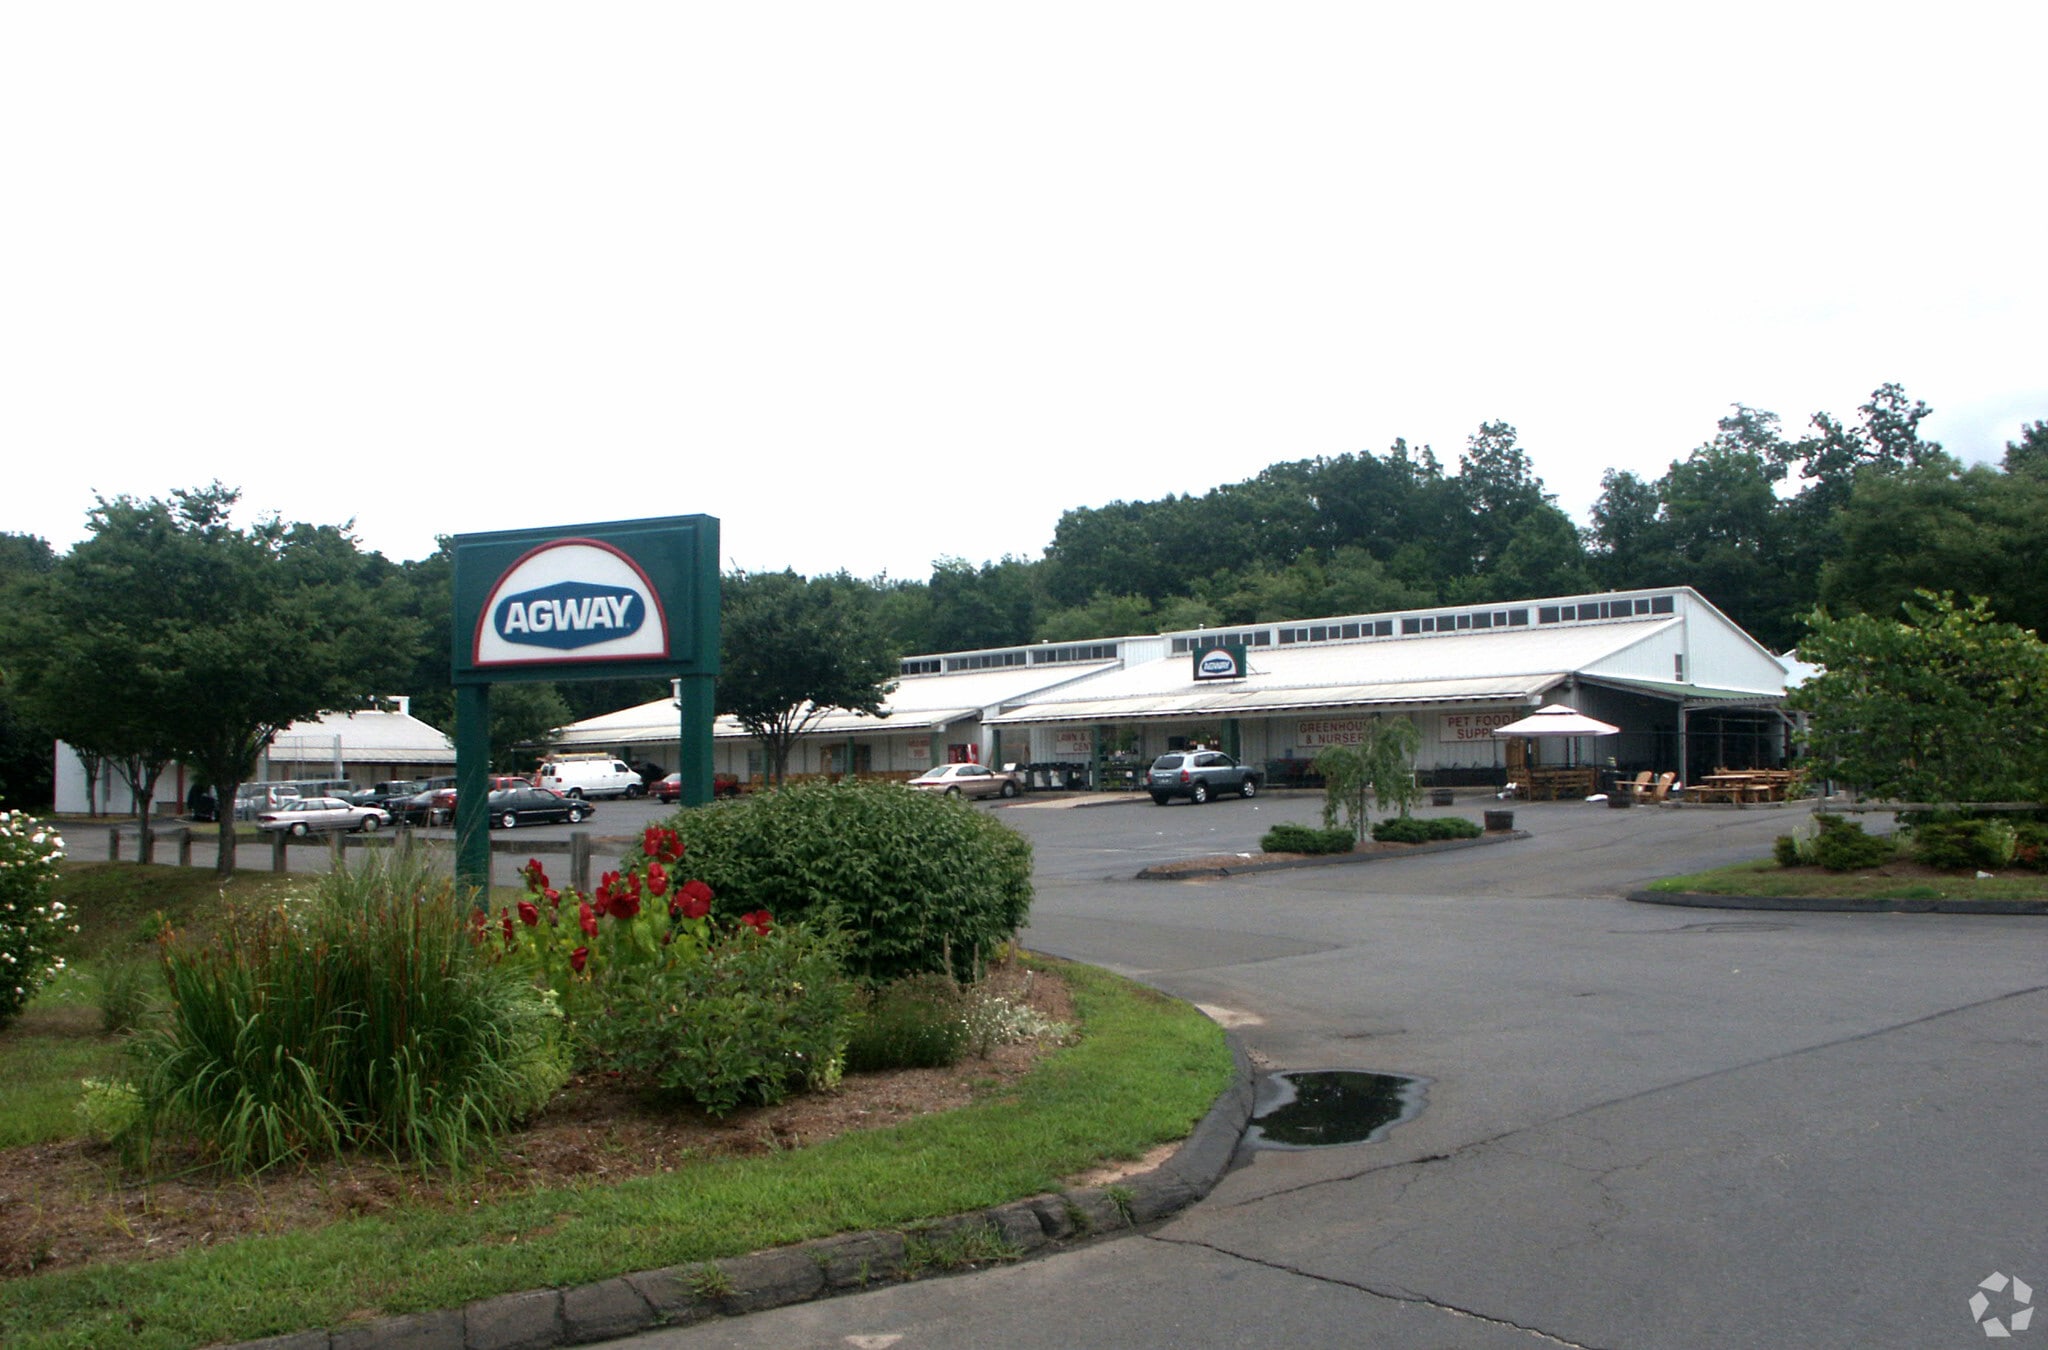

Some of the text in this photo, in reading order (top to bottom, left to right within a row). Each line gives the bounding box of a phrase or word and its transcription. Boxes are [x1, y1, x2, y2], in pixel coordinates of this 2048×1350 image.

[503, 595, 633, 634] AGWAY
[1448, 715, 1510, 727] PET FOOD
[1457, 728, 1495, 739] SUPPL
